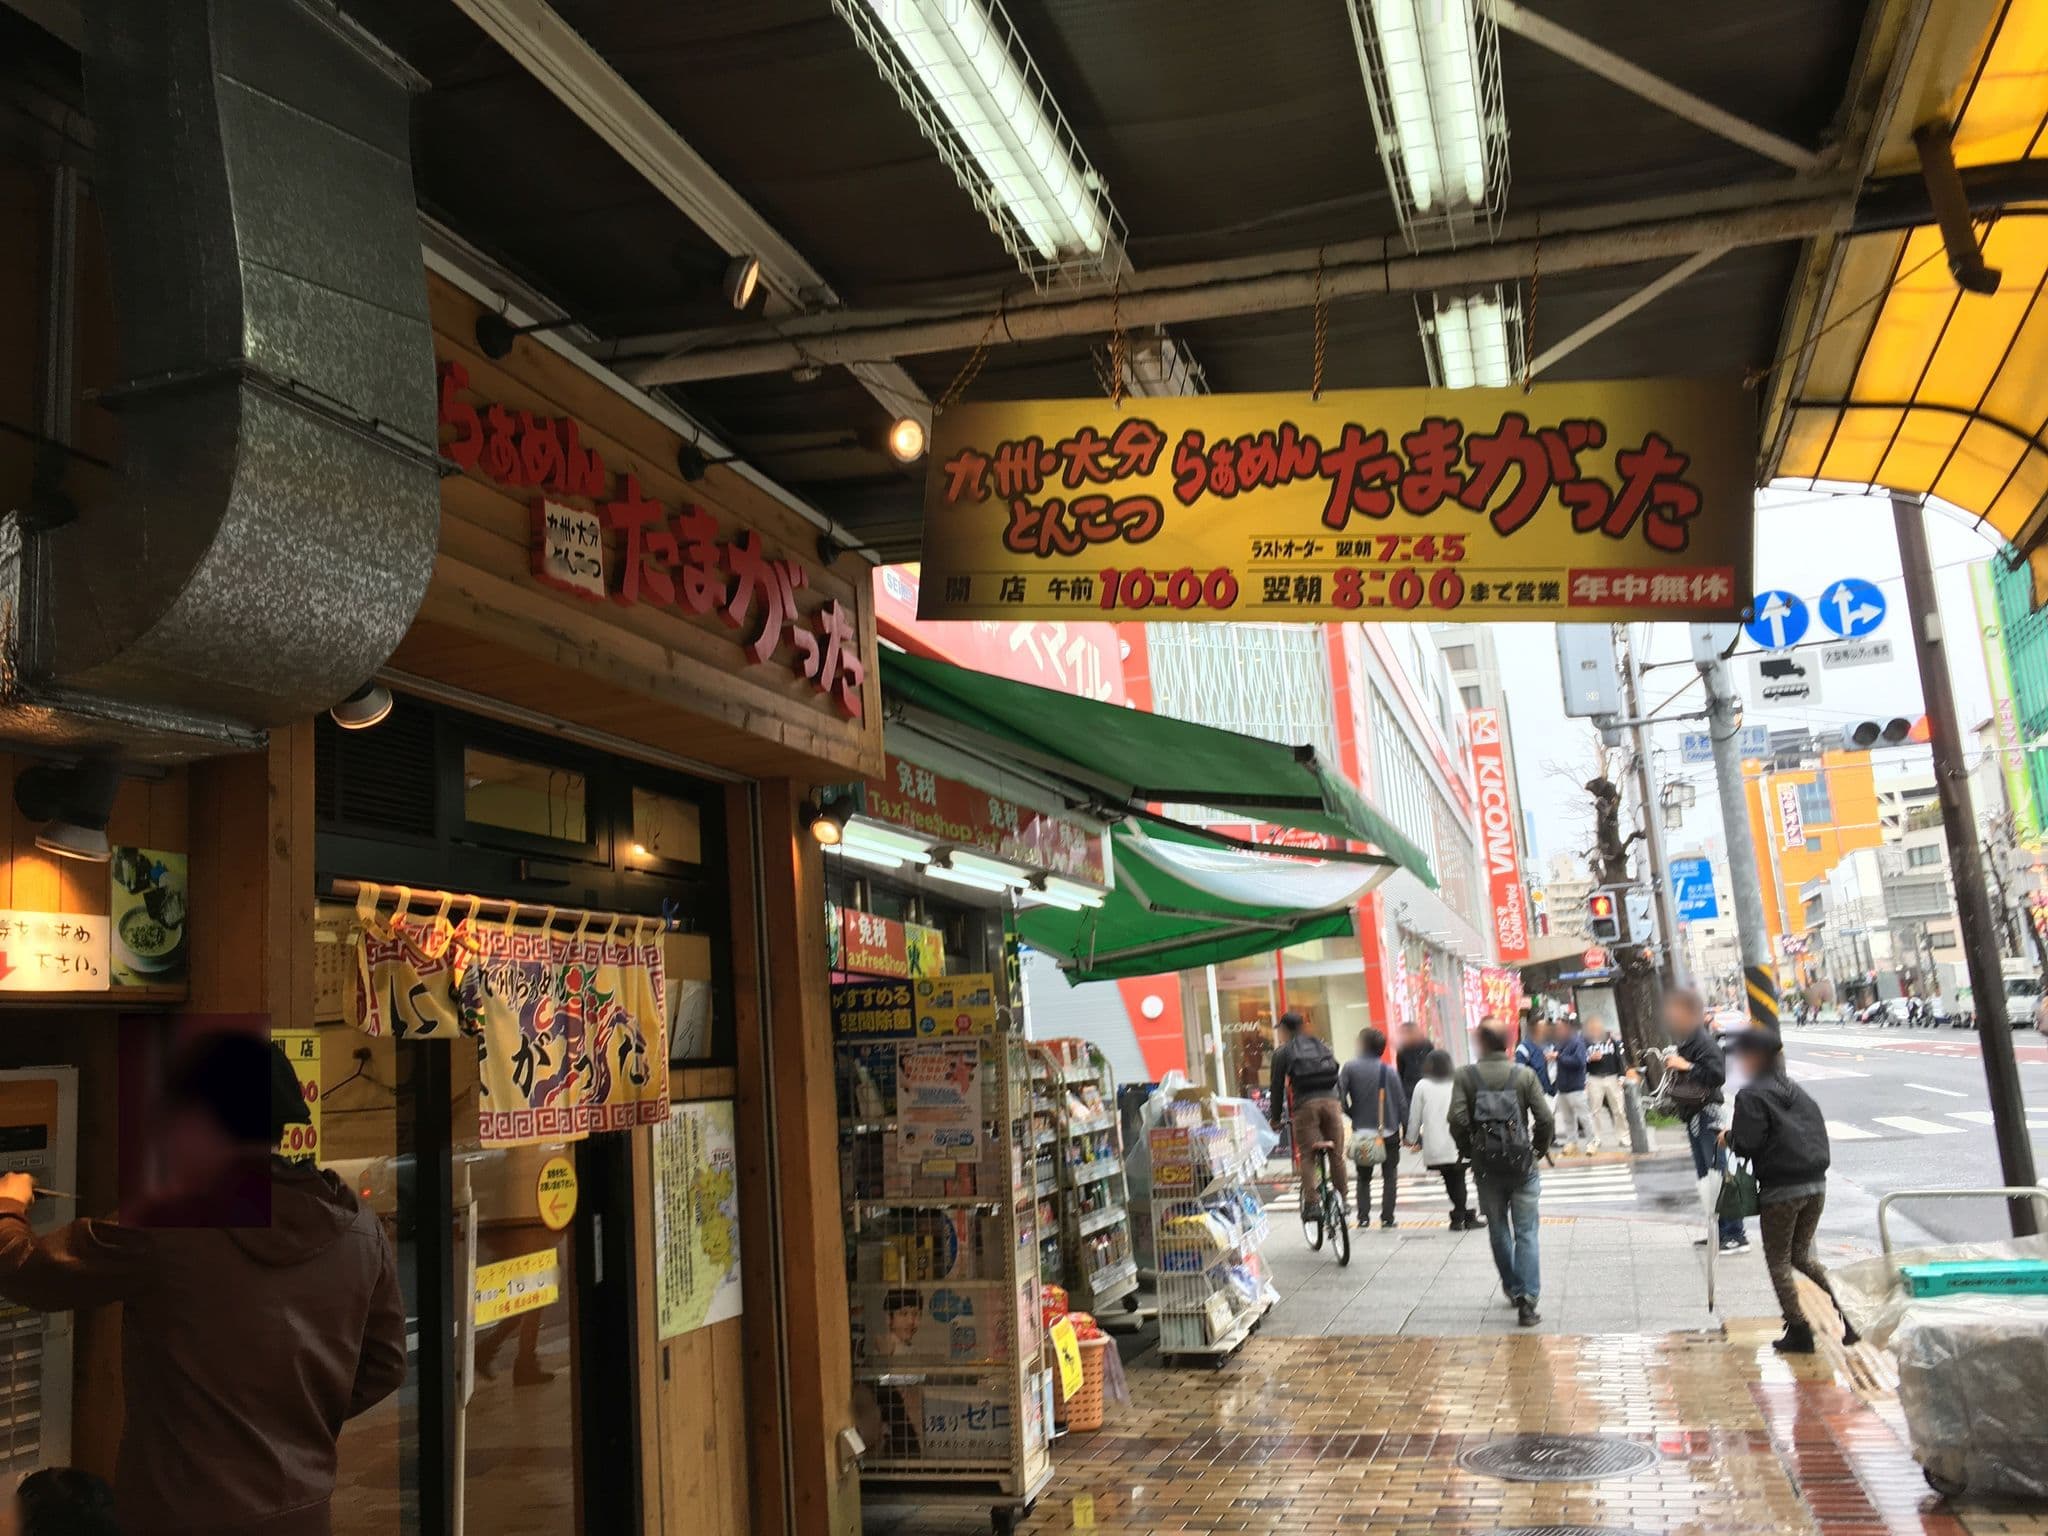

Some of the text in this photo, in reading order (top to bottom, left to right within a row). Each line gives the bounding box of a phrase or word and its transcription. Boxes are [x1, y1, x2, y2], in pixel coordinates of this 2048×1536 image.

[1171, 411, 1702, 553] らぁめん たまがった
[1003, 494, 1164, 557] とんこつ
[602, 472, 865, 719] たまがった
[1571, 573, 1730, 604] 年中無休
[1477, 754, 1514, 875] KICONA
[840, 945, 908, 975] axFreeShop
[858, 915, 888, 948] 免税
